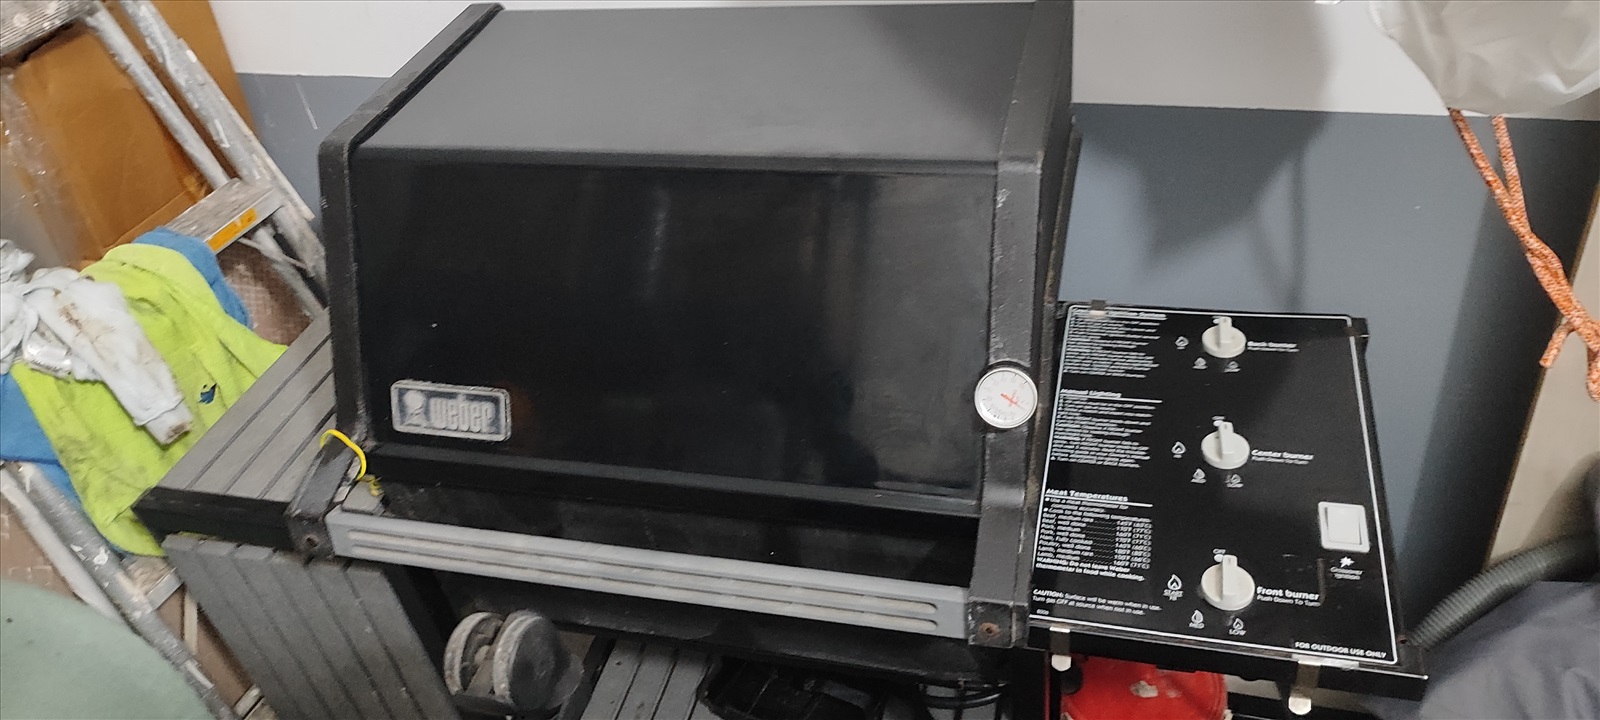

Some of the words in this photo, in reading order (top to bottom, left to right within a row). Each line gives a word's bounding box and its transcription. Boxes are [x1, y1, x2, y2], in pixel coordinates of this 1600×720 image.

[430, 392, 497, 433] weber
[1251, 449, 1281, 457] Center
[1283, 452, 1314, 460] burner
[1046, 488, 1067, 496] Meat
[1069, 490, 1128, 501] Temperatures
[1033, 589, 1063, 598] CAUTION:
[1257, 586, 1283, 596] Front
[1285, 589, 1319, 600] burner
[1229, 628, 1246, 636] LOW
[1295, 641, 1310, 649] FOR
[1311, 643, 1349, 654] OUTDOOR
[1350, 648, 1365, 656] USE
[1366, 650, 1386, 658] ONLY
